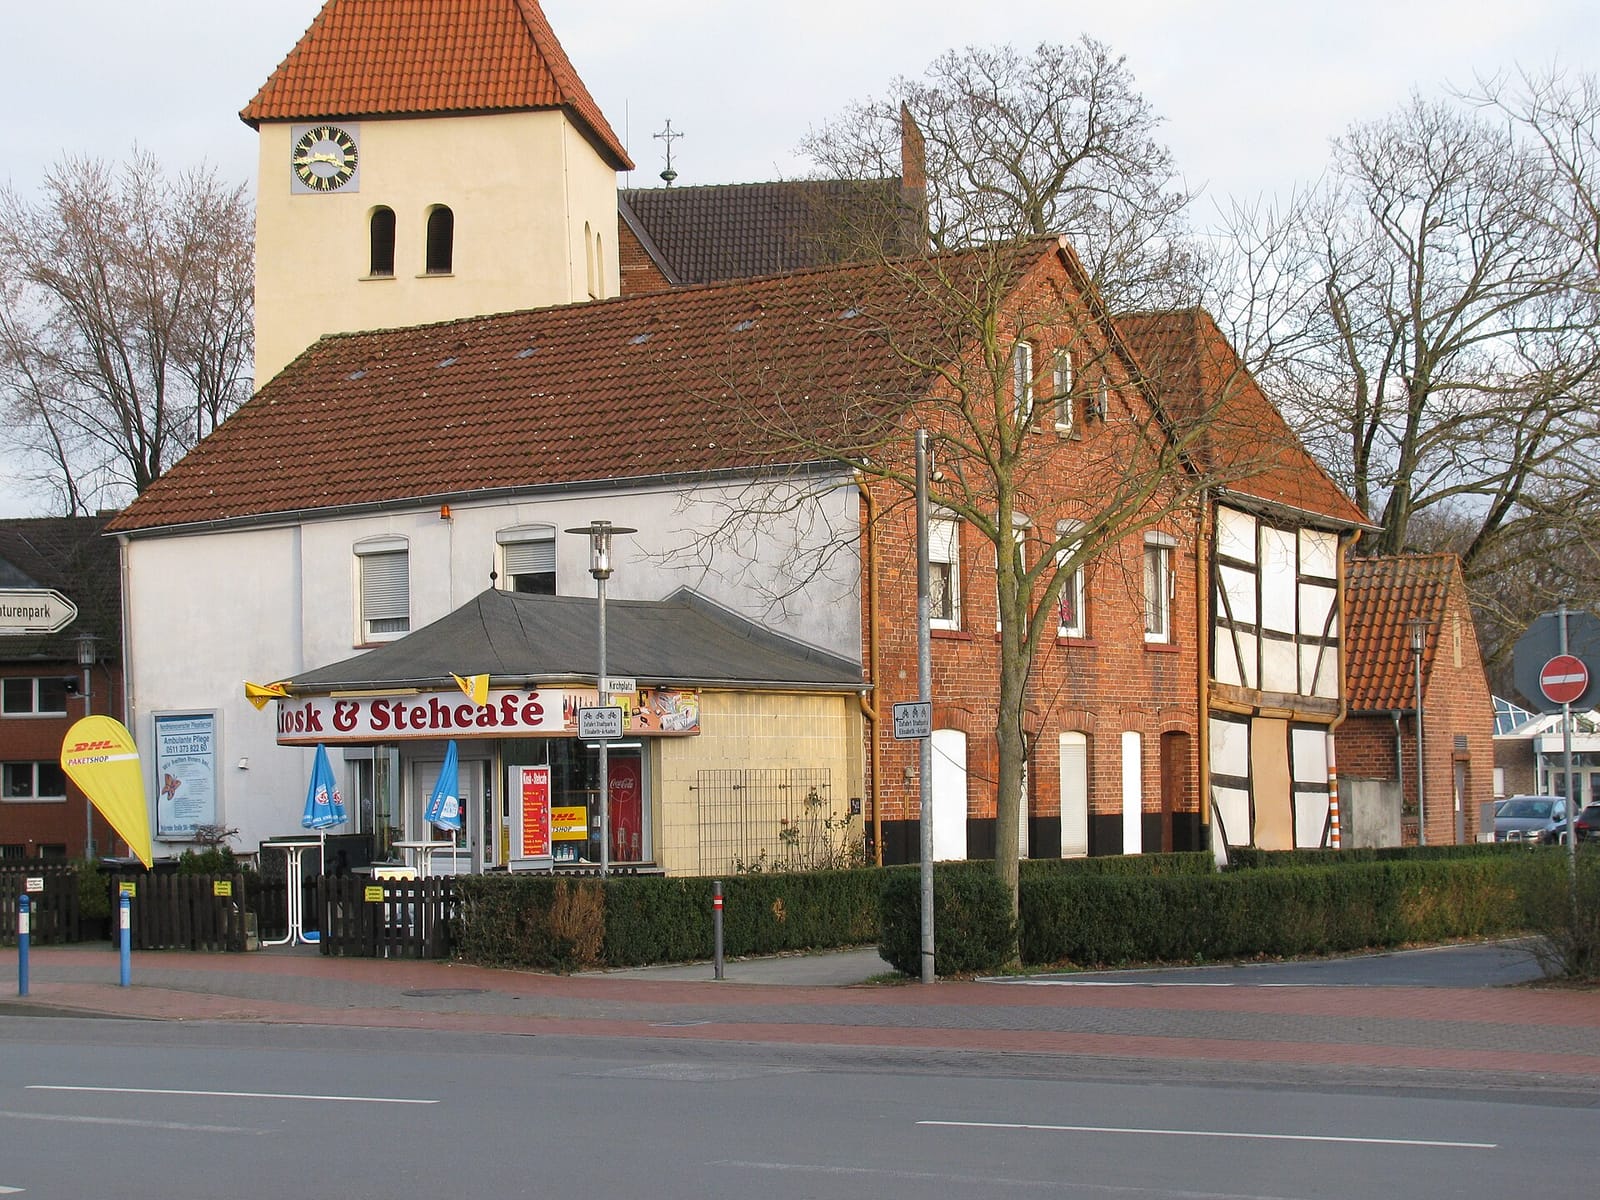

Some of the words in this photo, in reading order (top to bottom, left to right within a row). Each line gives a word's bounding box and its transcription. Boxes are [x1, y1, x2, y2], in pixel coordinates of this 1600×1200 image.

[609, 681, 633, 692] Kirchplatz
[332, 701, 360, 731] &
[370, 692, 545, 731] Stehcafé
[164, 736, 192, 745] Ambulante
[192, 735, 209, 744] Pflege
[74, 740, 113, 752] DHL
[68, 755, 110, 766] PAKETSHOP
